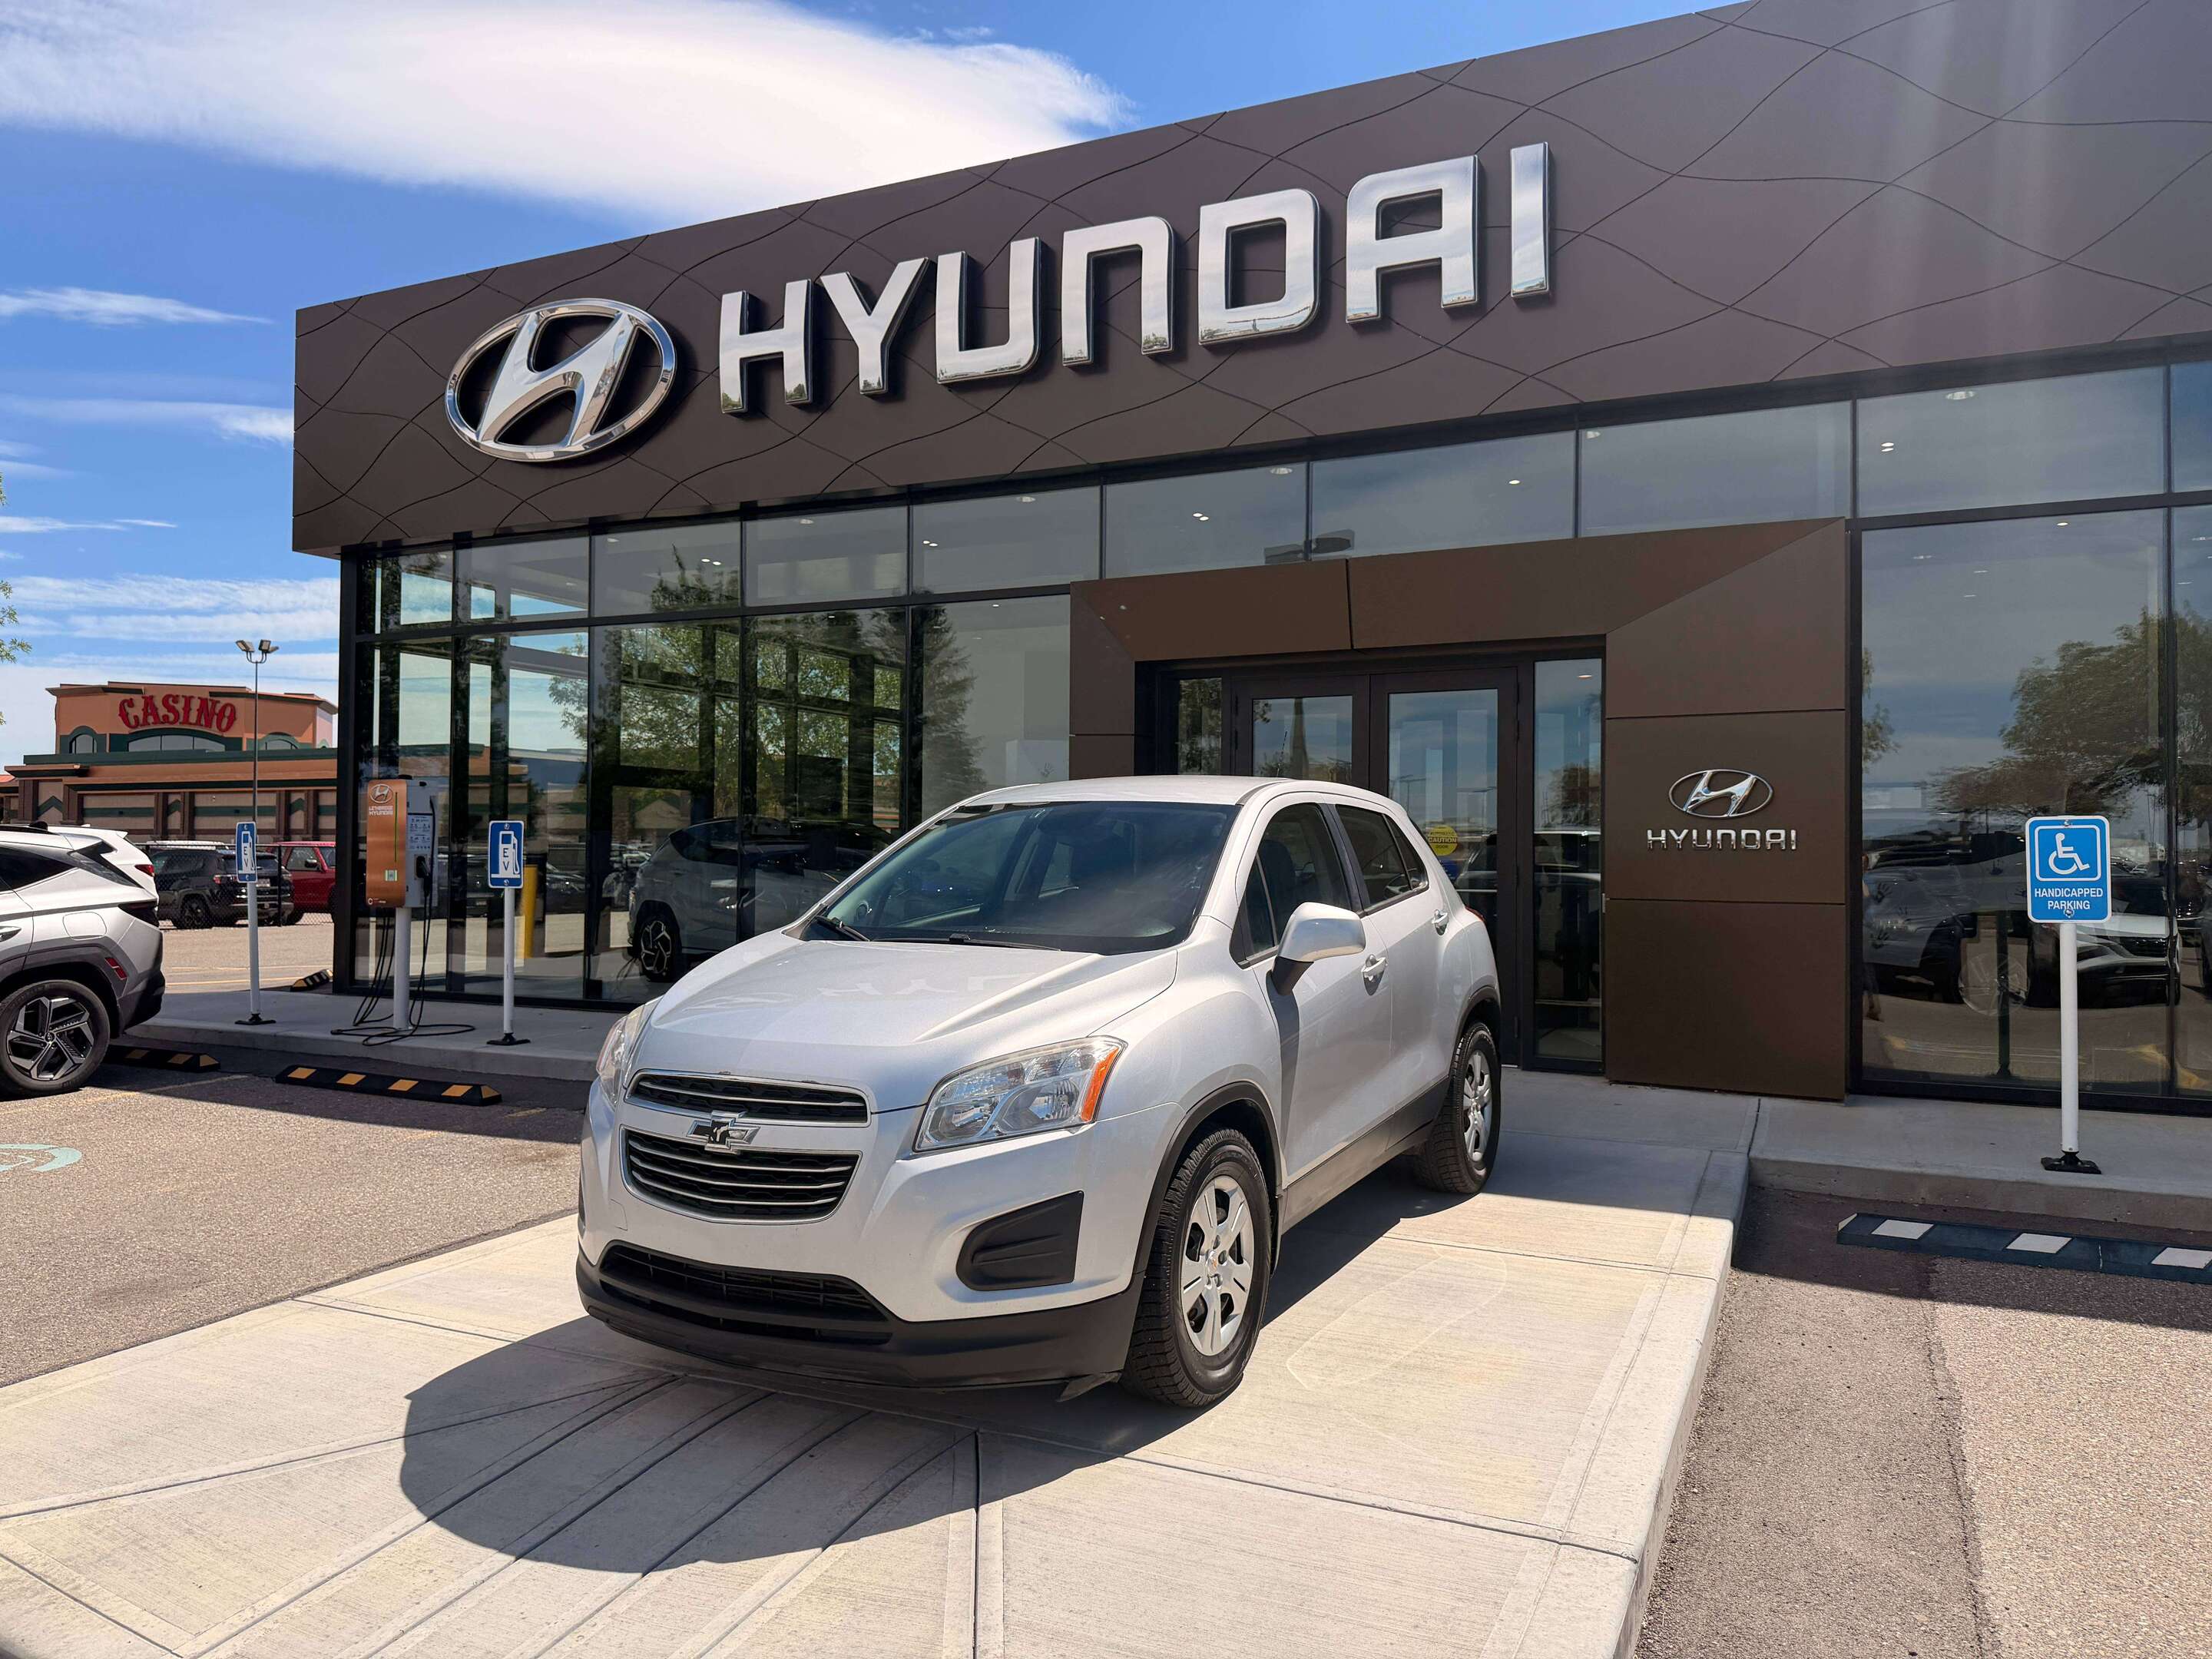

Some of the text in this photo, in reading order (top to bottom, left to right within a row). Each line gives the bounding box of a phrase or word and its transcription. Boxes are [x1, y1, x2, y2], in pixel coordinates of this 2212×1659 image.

[720, 141, 1552, 414] HYUNDAI
[118, 694, 237, 733] CASINO
[1647, 829, 1797, 849] HYUNDAI
[2035, 888, 2103, 897] HANDICAPPED
[2048, 900, 2091, 909] PARKING
